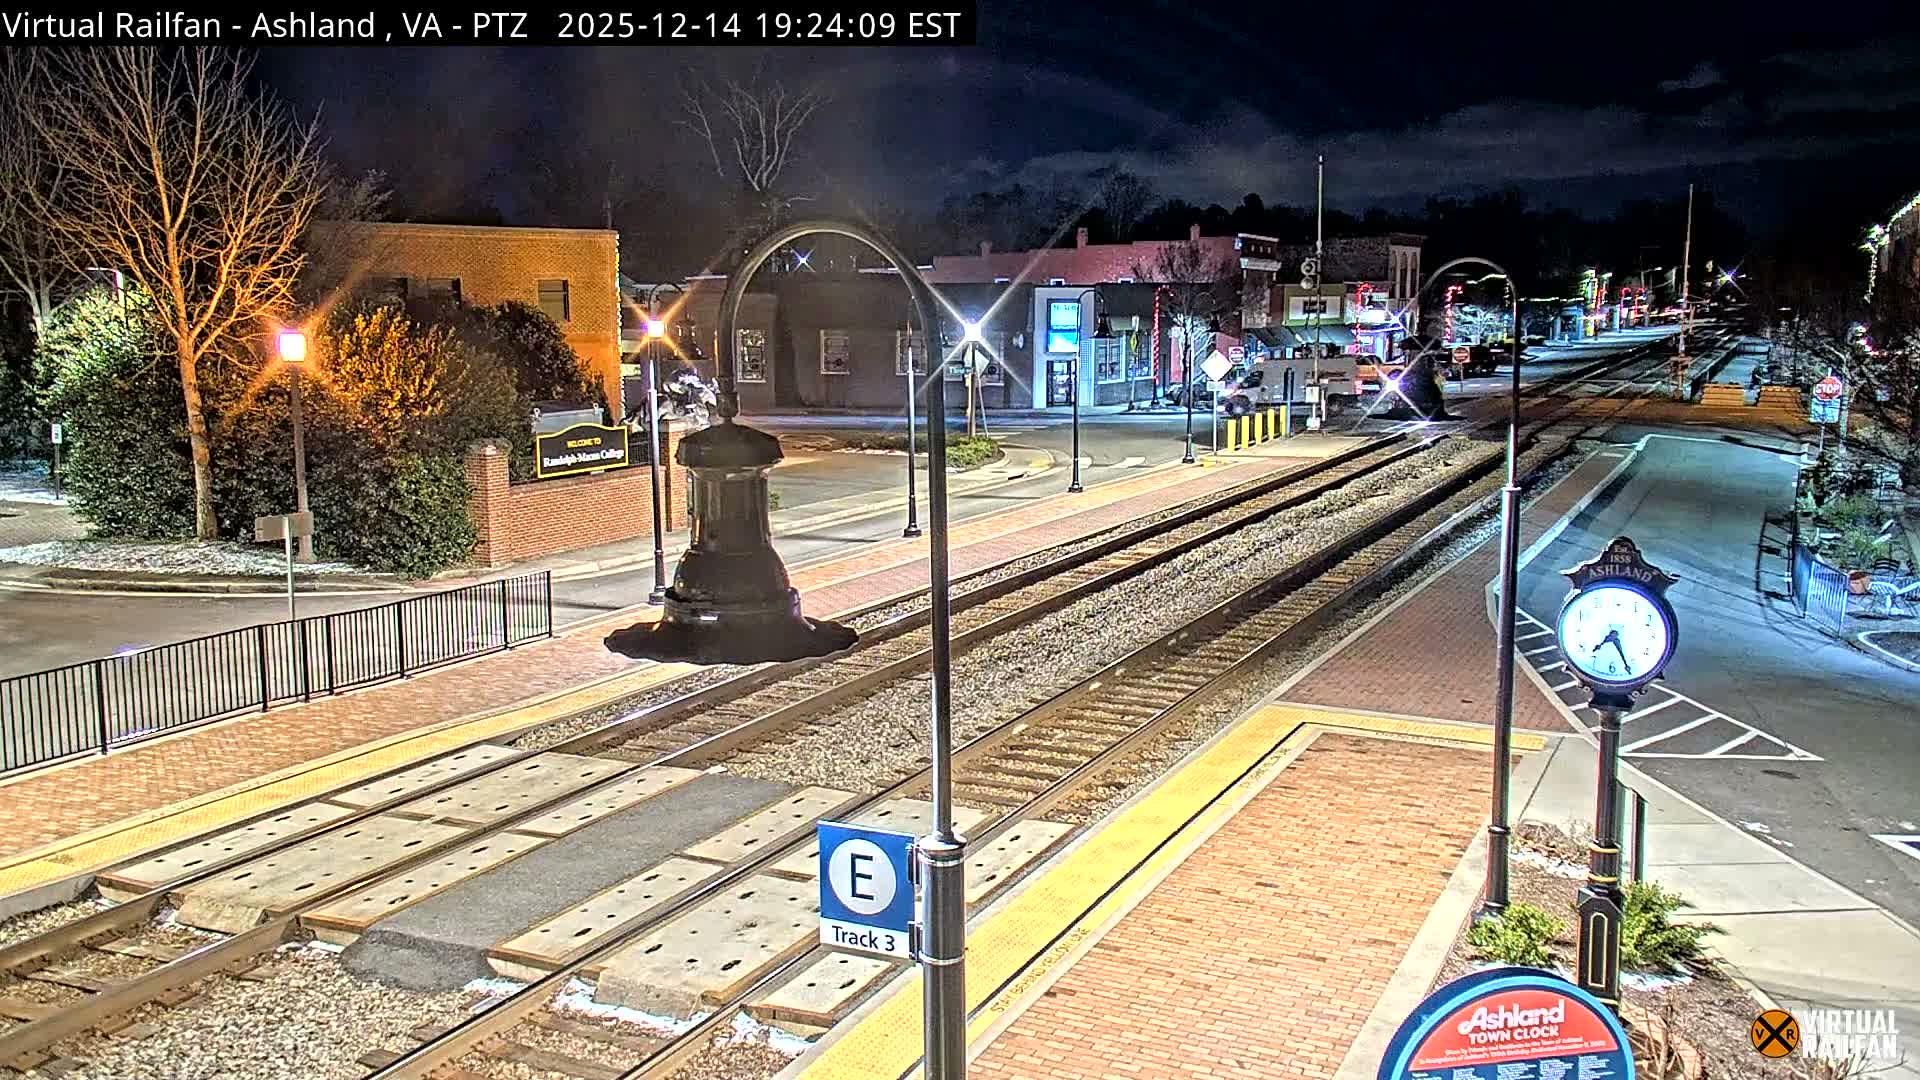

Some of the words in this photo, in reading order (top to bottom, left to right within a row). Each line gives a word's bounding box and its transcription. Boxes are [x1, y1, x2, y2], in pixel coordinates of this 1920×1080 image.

[1816, 384, 1840, 393] STOP
[1588, 564, 1653, 583] ASHLAND
[850, 853, 875, 901] E
[832, 925, 879, 950] Track
[885, 935, 895, 952] 3
[1457, 999, 1565, 1036] Ashland
[1468, 1029, 1511, 1045] TOWN
[1512, 1024, 1559, 1040] CLOCK
